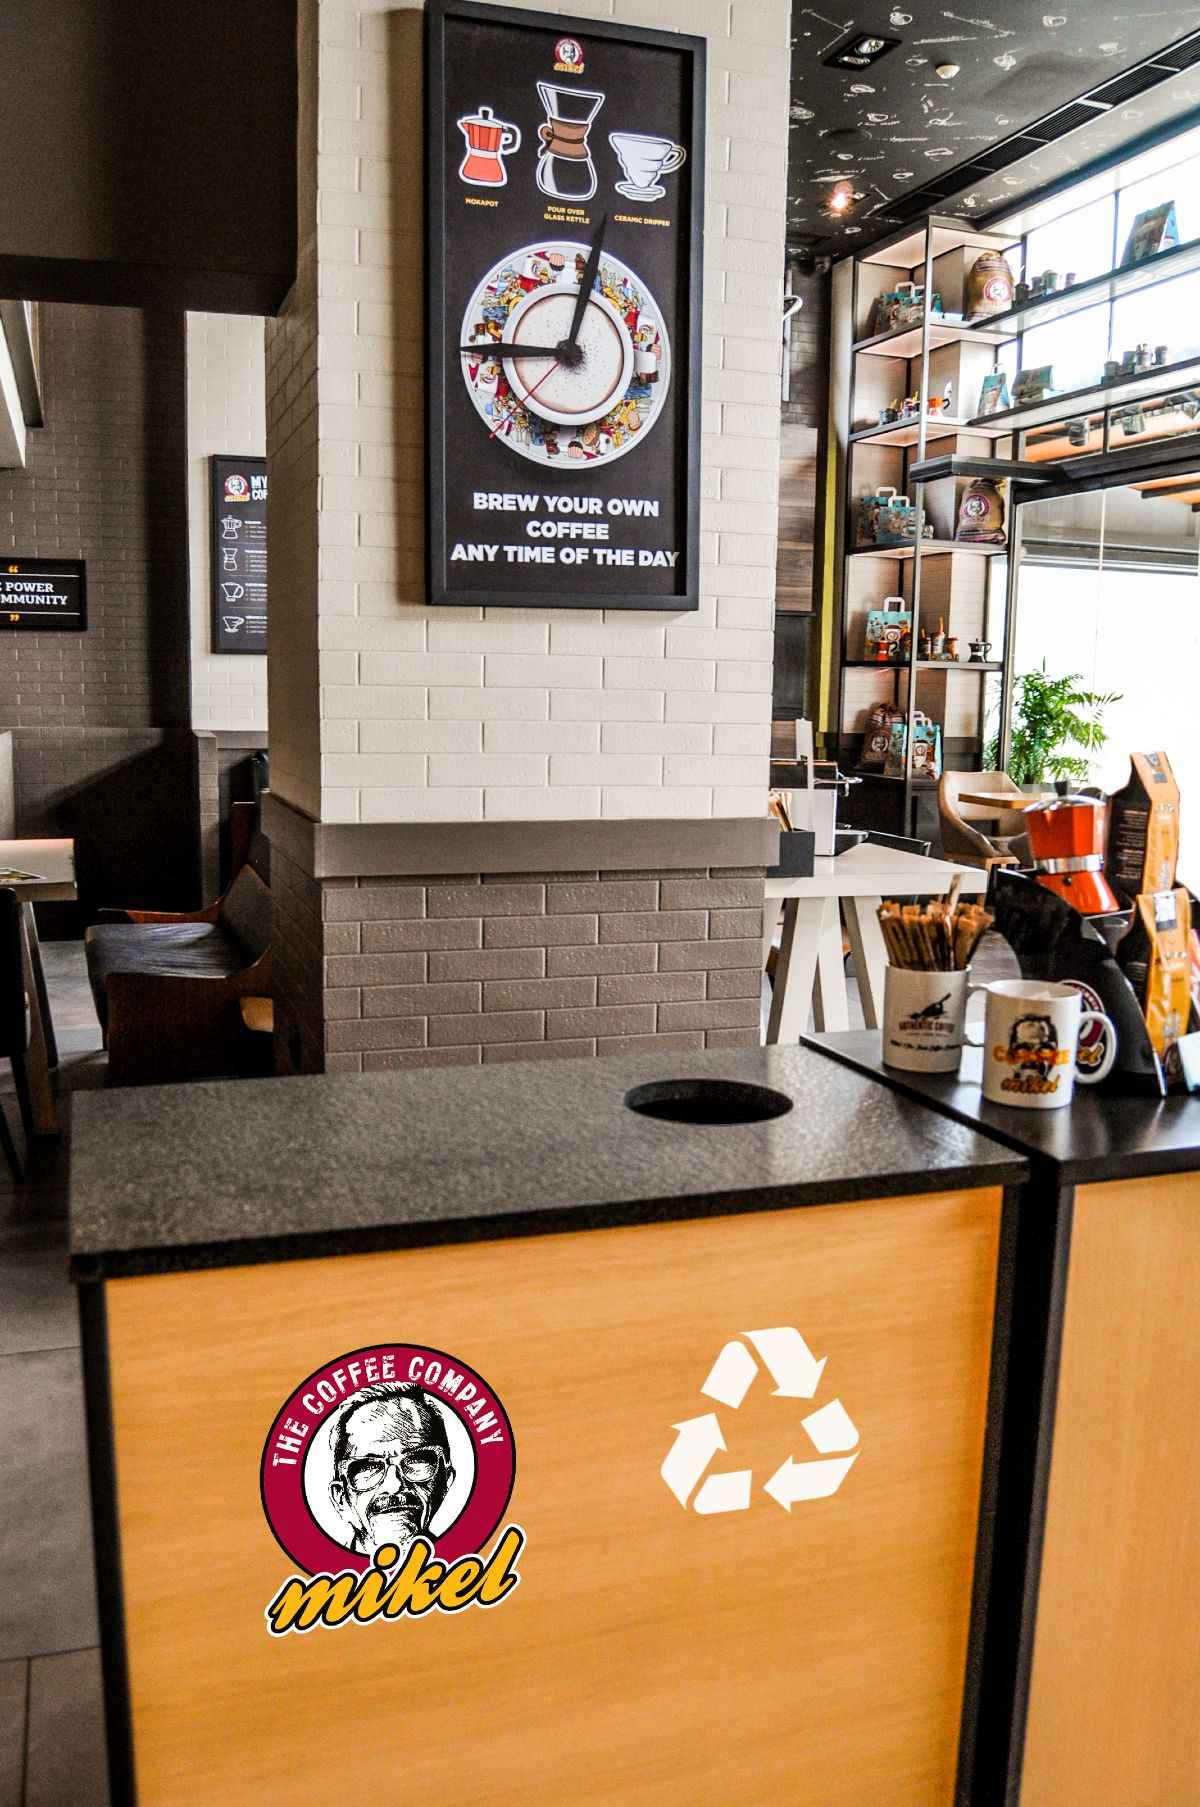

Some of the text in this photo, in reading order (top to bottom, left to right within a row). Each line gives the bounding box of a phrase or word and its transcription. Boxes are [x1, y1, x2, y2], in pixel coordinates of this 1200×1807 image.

[464, 197, 499, 207] MOKAPOT
[543, 213, 590, 224] GLASS KETTLE
[547, 206, 585, 216] POUR OVER
[614, 214, 643, 224] CERAMIC
[473, 492, 659, 517] BREW YOUR OWN
[526, 520, 609, 540] COFFEE
[450, 543, 681, 568] ANY TIME OF THE DAY
[5, 582, 55, 593] POWER
[272, 1354, 505, 1468] THE COFFEE COMPANY
[267, 1526, 524, 1634] mikel
